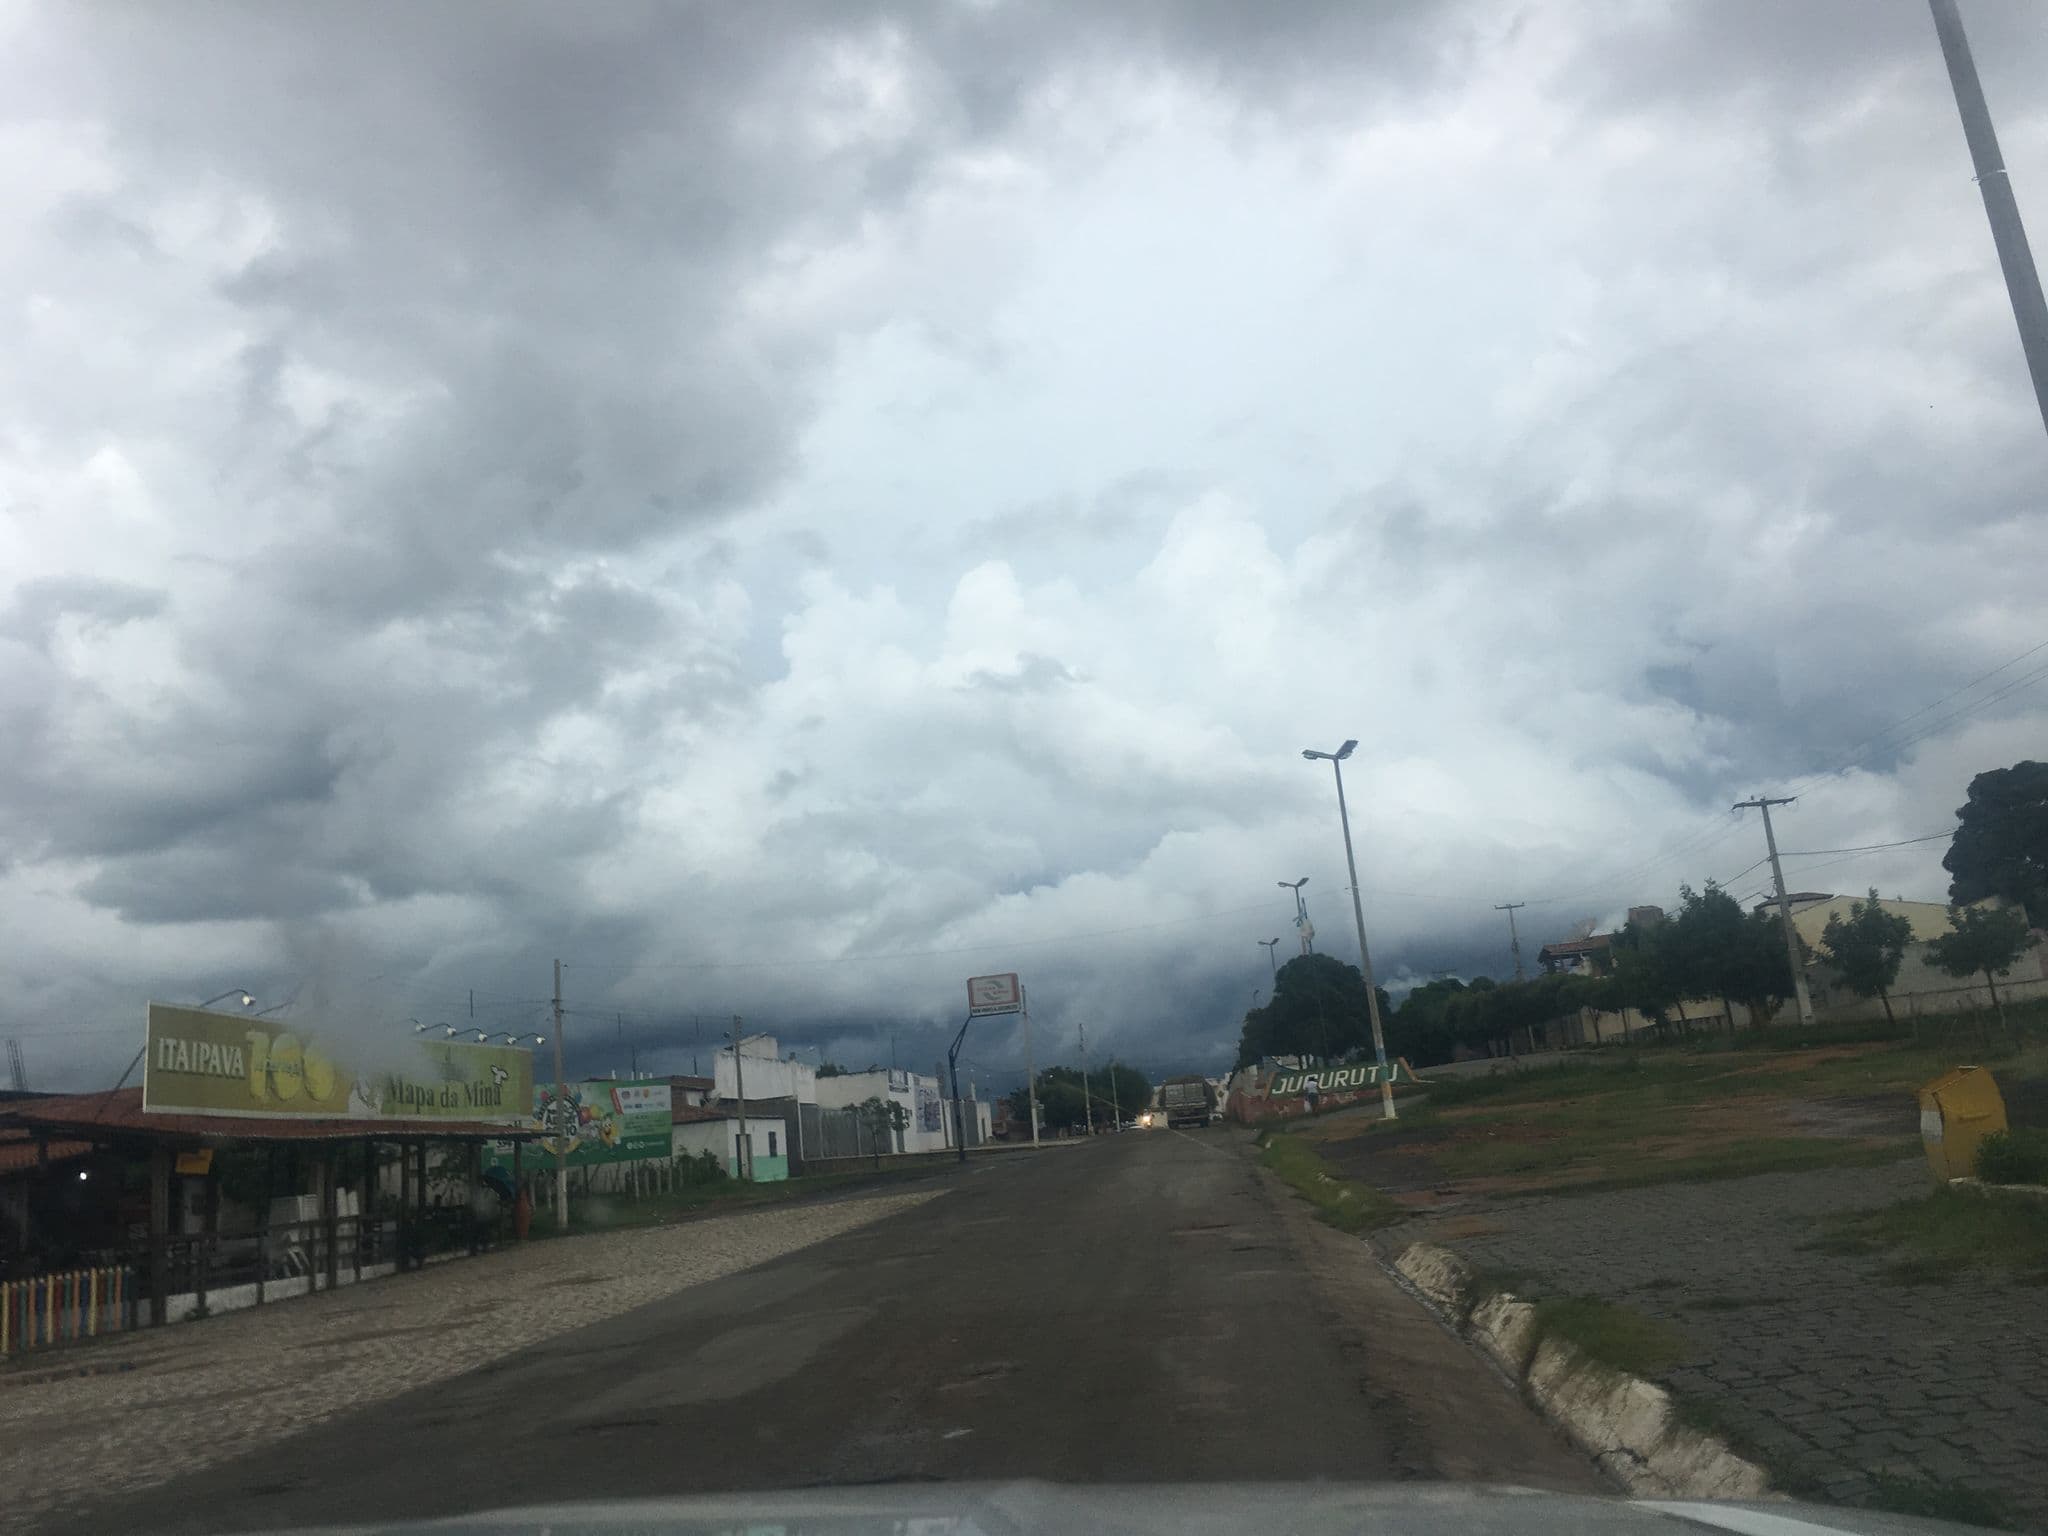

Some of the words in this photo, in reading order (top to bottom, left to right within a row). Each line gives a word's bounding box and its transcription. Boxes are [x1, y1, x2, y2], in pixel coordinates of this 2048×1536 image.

[156, 1036, 245, 1078] ITAIPAVA
[386, 1075, 435, 1113] Mapa
[440, 1085, 459, 1108] da
[463, 1078, 502, 1107] Mina
